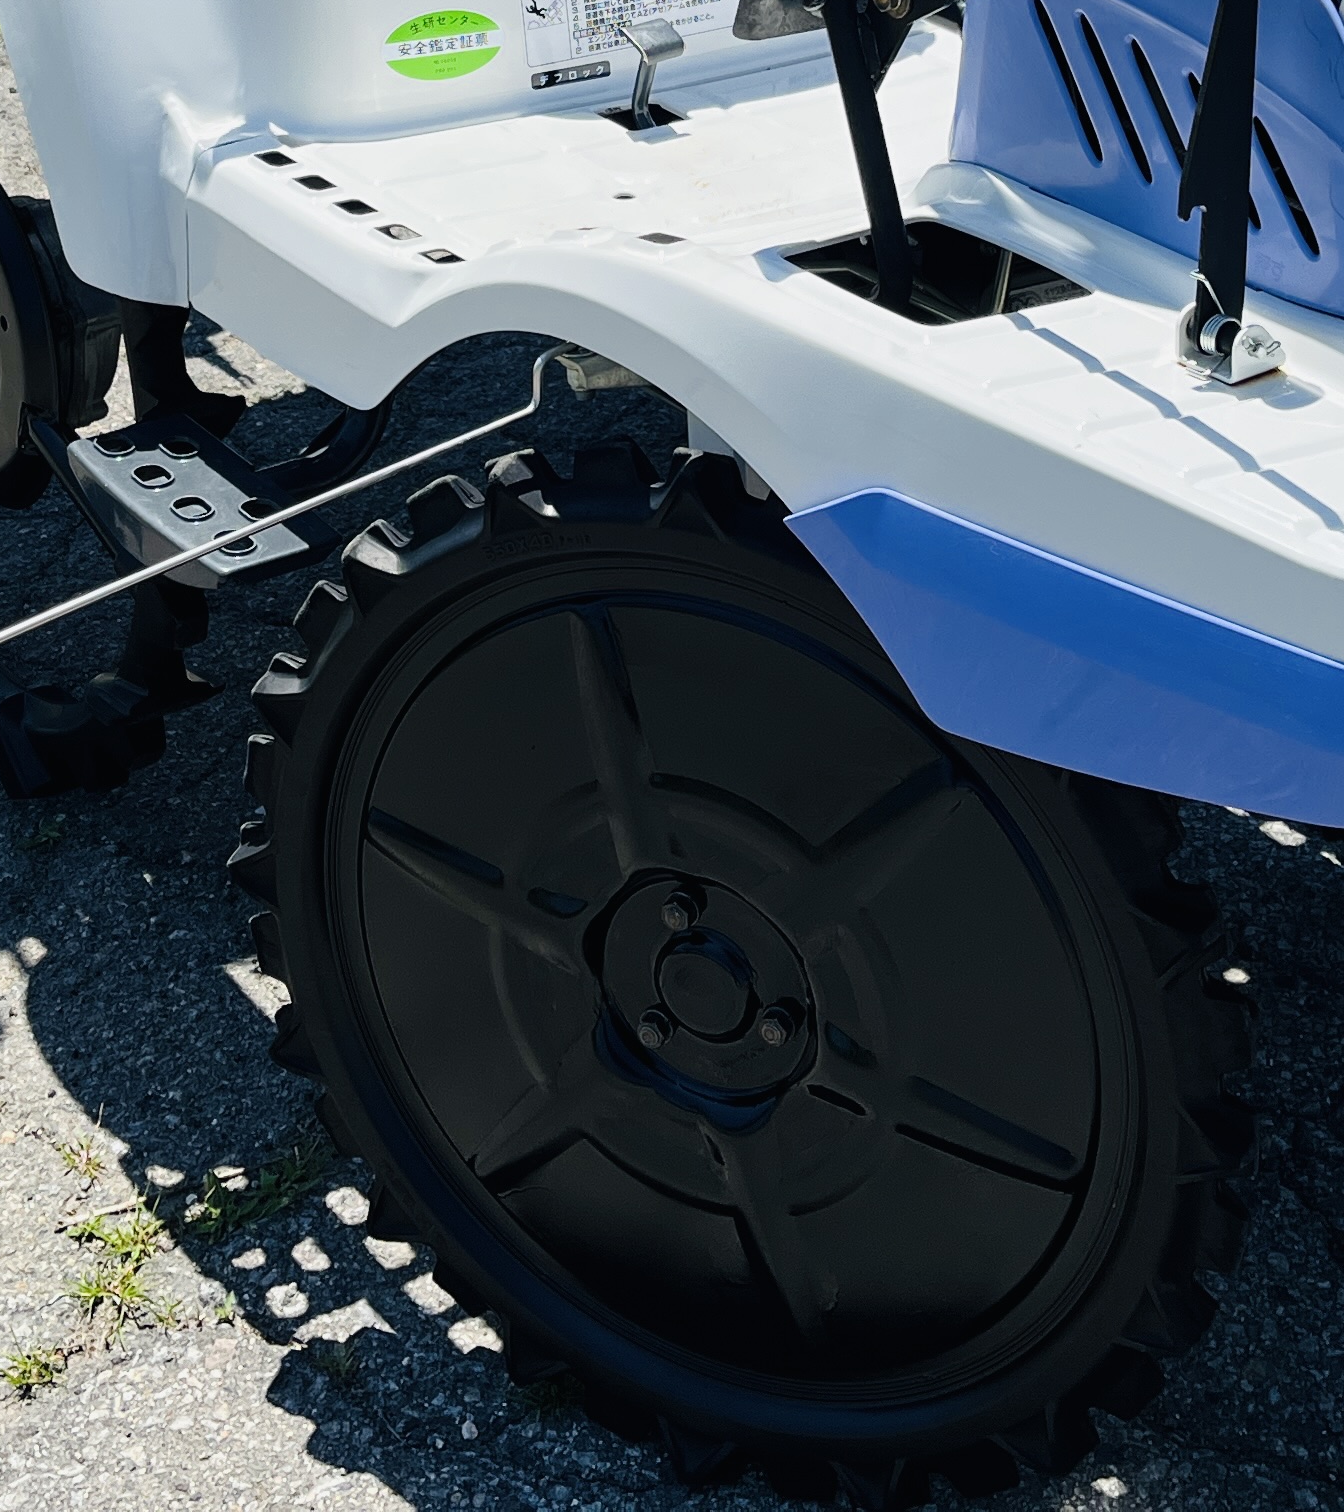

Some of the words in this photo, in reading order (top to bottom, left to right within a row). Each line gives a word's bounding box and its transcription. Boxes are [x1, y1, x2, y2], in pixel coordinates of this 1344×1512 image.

[409, 14, 479, 35] 生研センター
